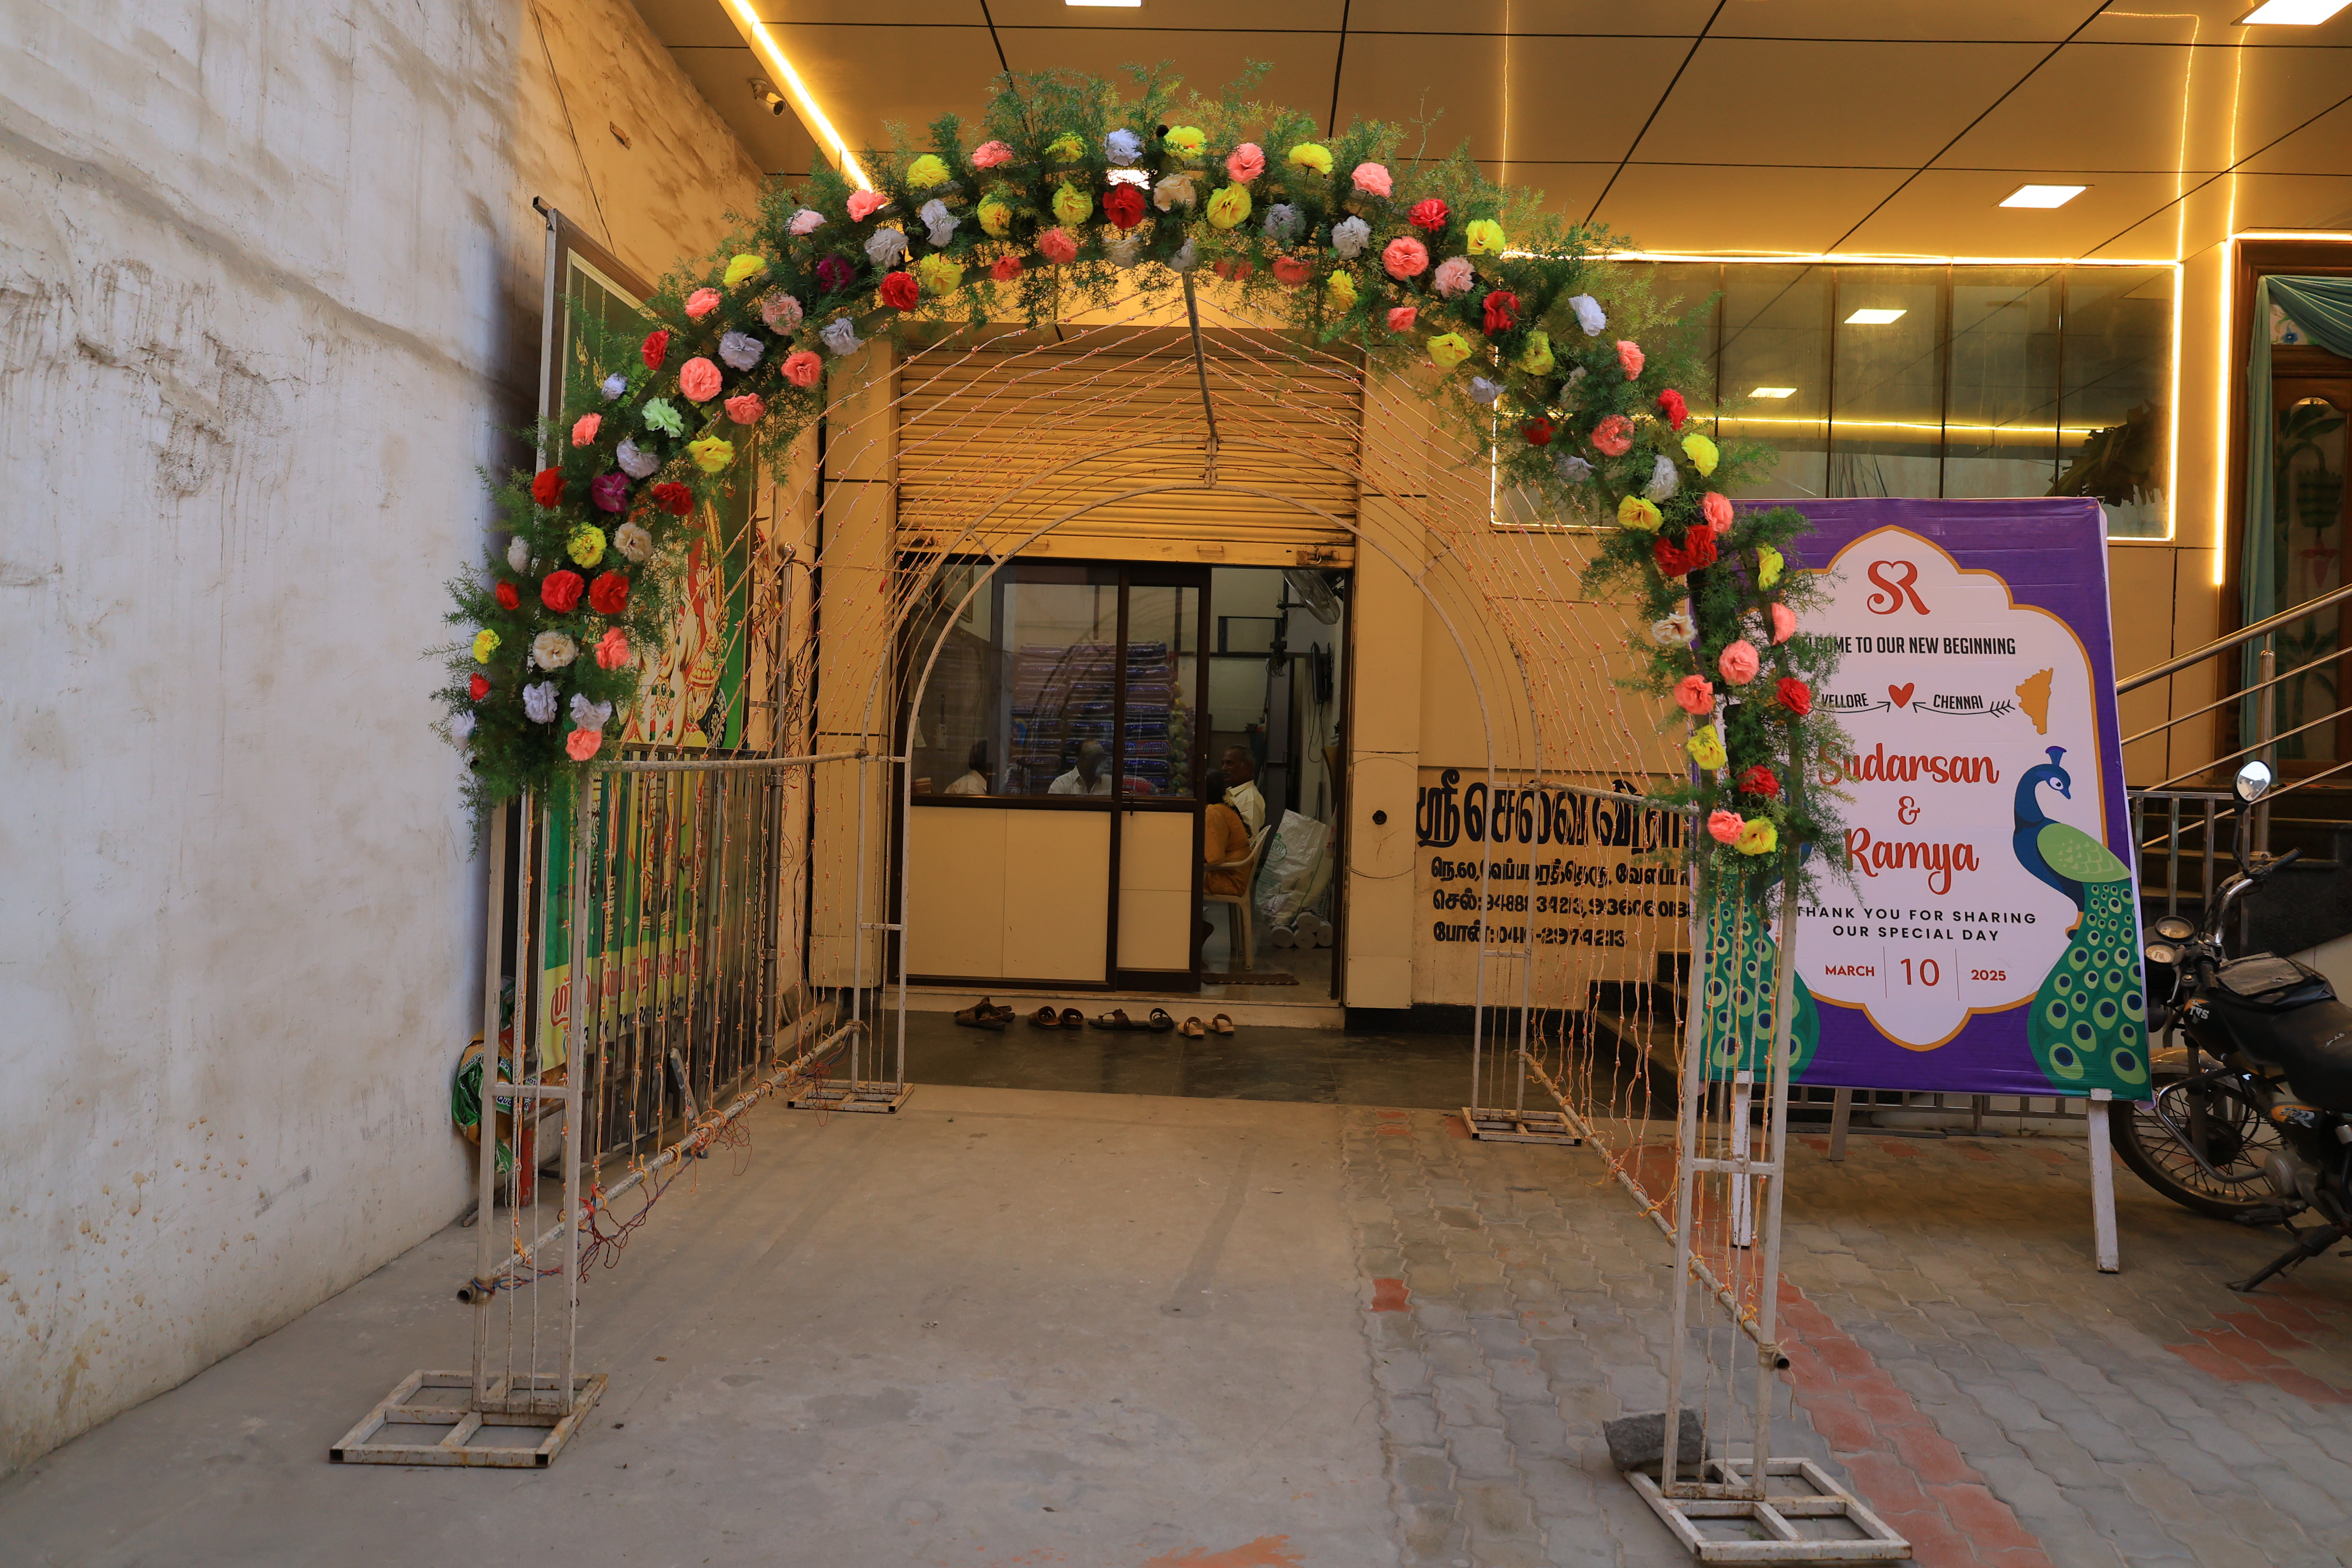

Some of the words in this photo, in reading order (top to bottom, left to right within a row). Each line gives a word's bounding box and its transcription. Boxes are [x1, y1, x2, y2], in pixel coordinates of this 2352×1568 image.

[1867, 560, 1931, 615] SR
[1803, 637, 1852, 653] LCOME
[1856, 637, 1872, 653] TO
[1877, 637, 1904, 653] OUR
[1910, 637, 1938, 654] NEW
[1944, 638, 2016, 655] BEGINNING
[1821, 693, 1869, 708] VELLORE
[1933, 694, 1983, 710] CHENNAI
[1818, 742, 1999, 785] Sudarsan
[1898, 796, 1920, 825] &
[1845, 828, 1979, 895] Ramya
[1797, 906, 1855, 918] THANK
[1864, 908, 1900, 920] YOU
[1910, 909, 1944, 922] FOR
[1953, 911, 2036, 924] SHARING
[1833, 925, 1869, 937] OUR
[1878, 927, 1954, 940] SPECIAL
[1963, 929, 1998, 941] DAY
[1825, 964, 1875, 977] MARCH
[1900, 958, 1940, 987] 10
[1971, 969, 2007, 981] 2025
[2189, 1005, 2210, 1020] TVS
